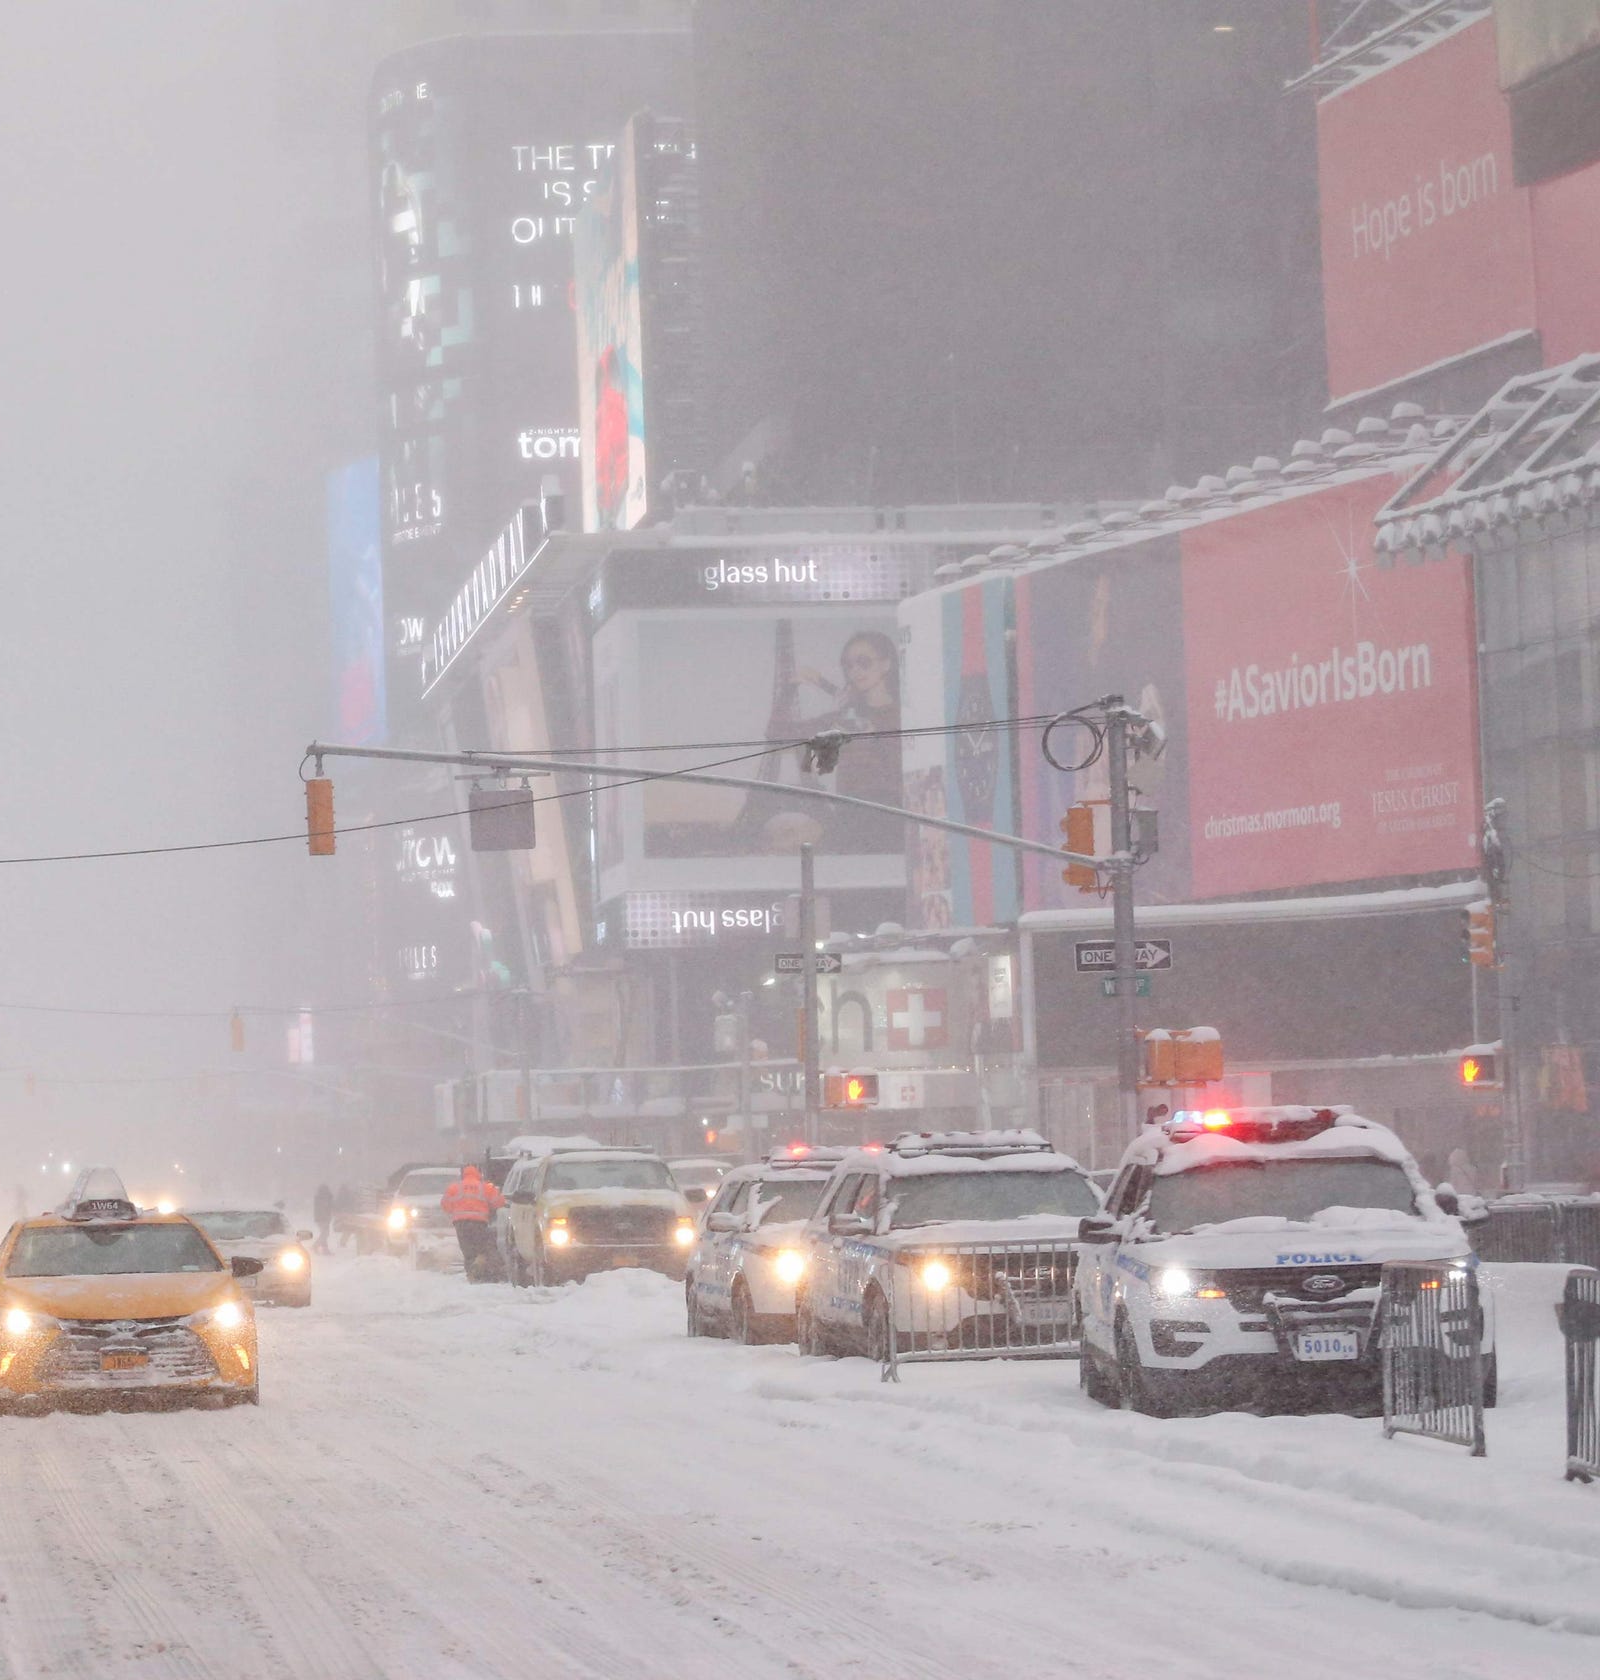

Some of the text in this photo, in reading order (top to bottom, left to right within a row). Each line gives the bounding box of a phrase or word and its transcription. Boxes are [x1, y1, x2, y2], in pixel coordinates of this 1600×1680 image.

[511, 145, 575, 171] THE
[1352, 152, 1498, 260] Hope is born
[704, 558, 819, 591] glass hut
[1214, 640, 1432, 722] #ASaviorIsBorn
[1204, 801, 1341, 840] christmas.mormon.org
[780, 959, 800, 968] ONE
[1083, 951, 1113, 962] ONE
[91, 1202, 119, 1210] 1W64
[1311, 1279, 1336, 1289] Ford
[1304, 1339, 1342, 1354] 5010
